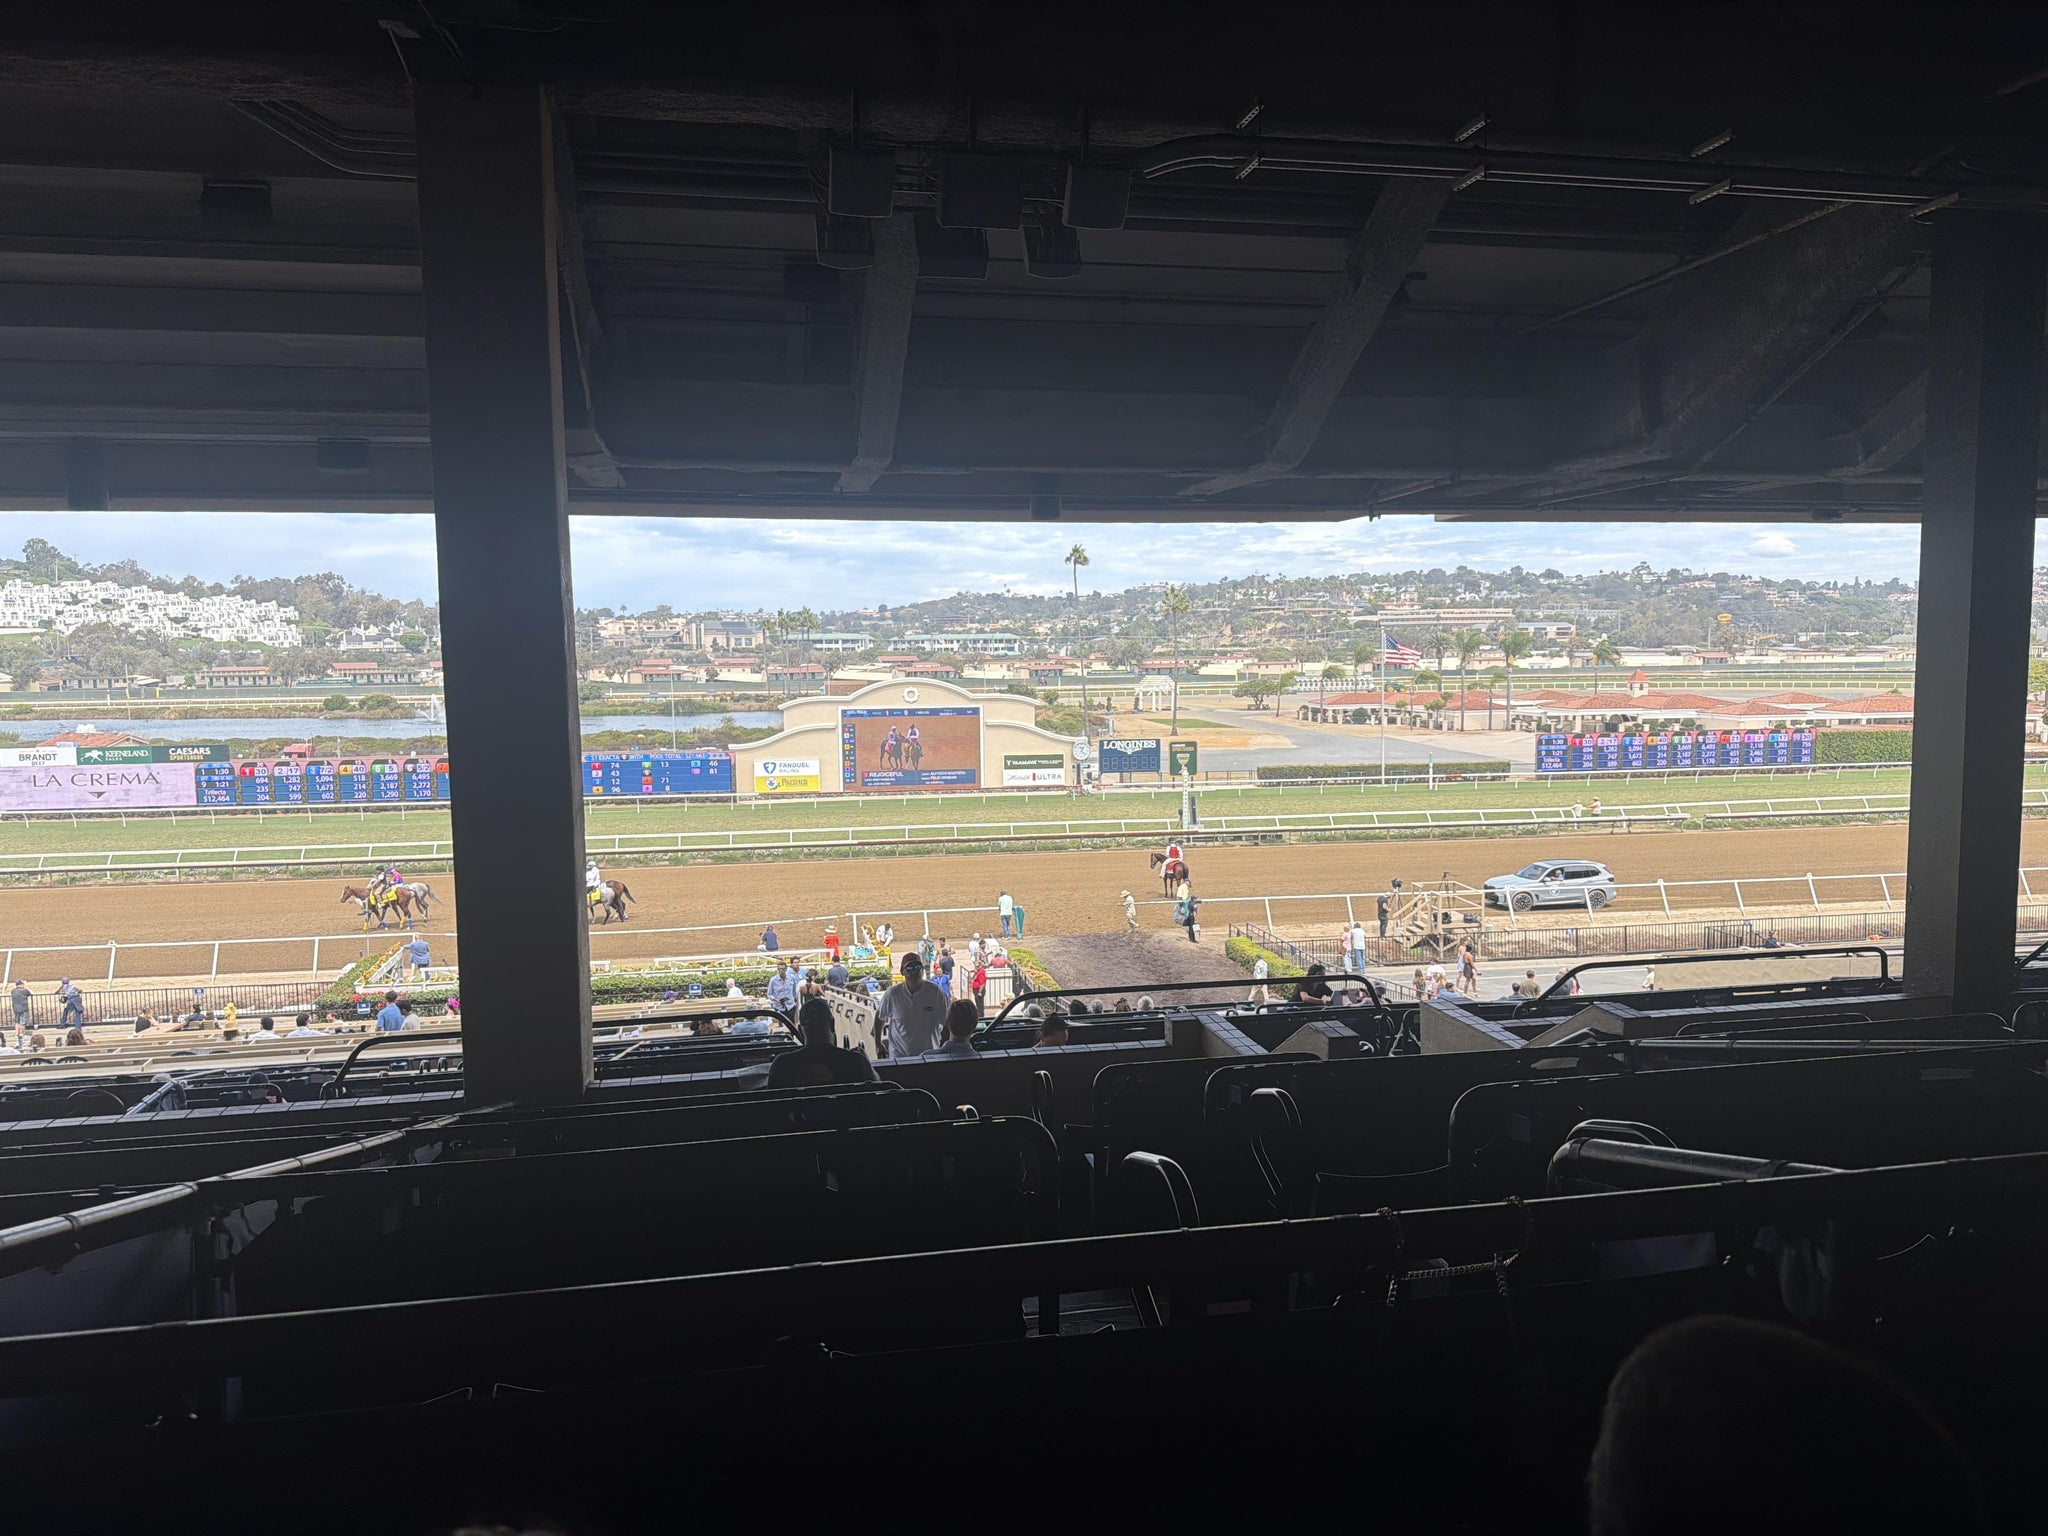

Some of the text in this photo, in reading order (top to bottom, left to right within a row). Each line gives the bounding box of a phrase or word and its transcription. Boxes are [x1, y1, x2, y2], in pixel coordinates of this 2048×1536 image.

[1103, 740, 1156, 750] LONGINES
[105, 750, 148, 758] KEENELAND
[169, 747, 211, 755] CAESARS
[19, 754, 58, 762] BRANDT
[32, 772, 160, 788] LA CREMA
